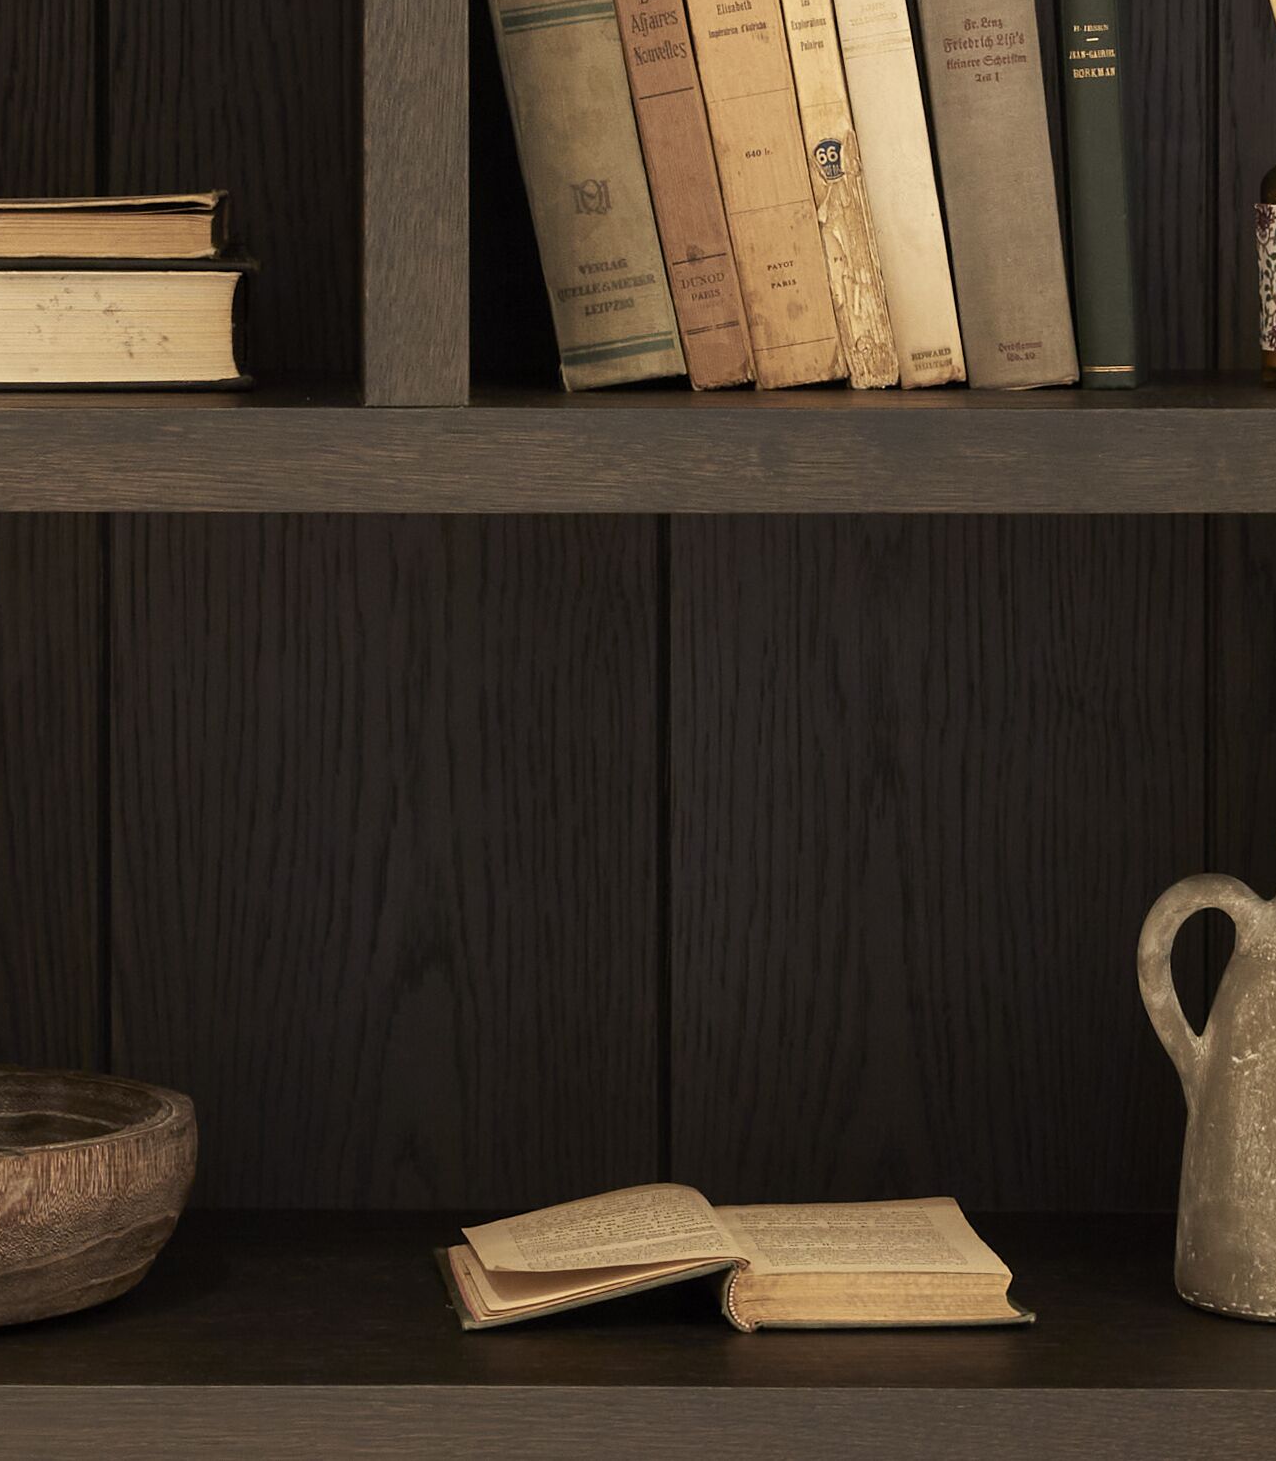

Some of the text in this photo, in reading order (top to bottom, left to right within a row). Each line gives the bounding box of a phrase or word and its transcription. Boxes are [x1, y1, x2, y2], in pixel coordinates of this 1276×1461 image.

[716, 0, 752, 16] Elisabeth
[631, 10, 678, 37] Affaires
[634, 39, 688, 66] Nouvelles
[1073, 67, 1116, 78] BORKMAN
[745, 149, 762, 159] 640
[816, 145, 839, 165] 66
[578, 258, 628, 275] VERLAG
[767, 260, 794, 271] PAYOT
[681, 272, 725, 289] DUNOD
[771, 279, 797, 289] PARIS
[691, 289, 721, 302] PARIS
[911, 347, 951, 361] EDWARD
